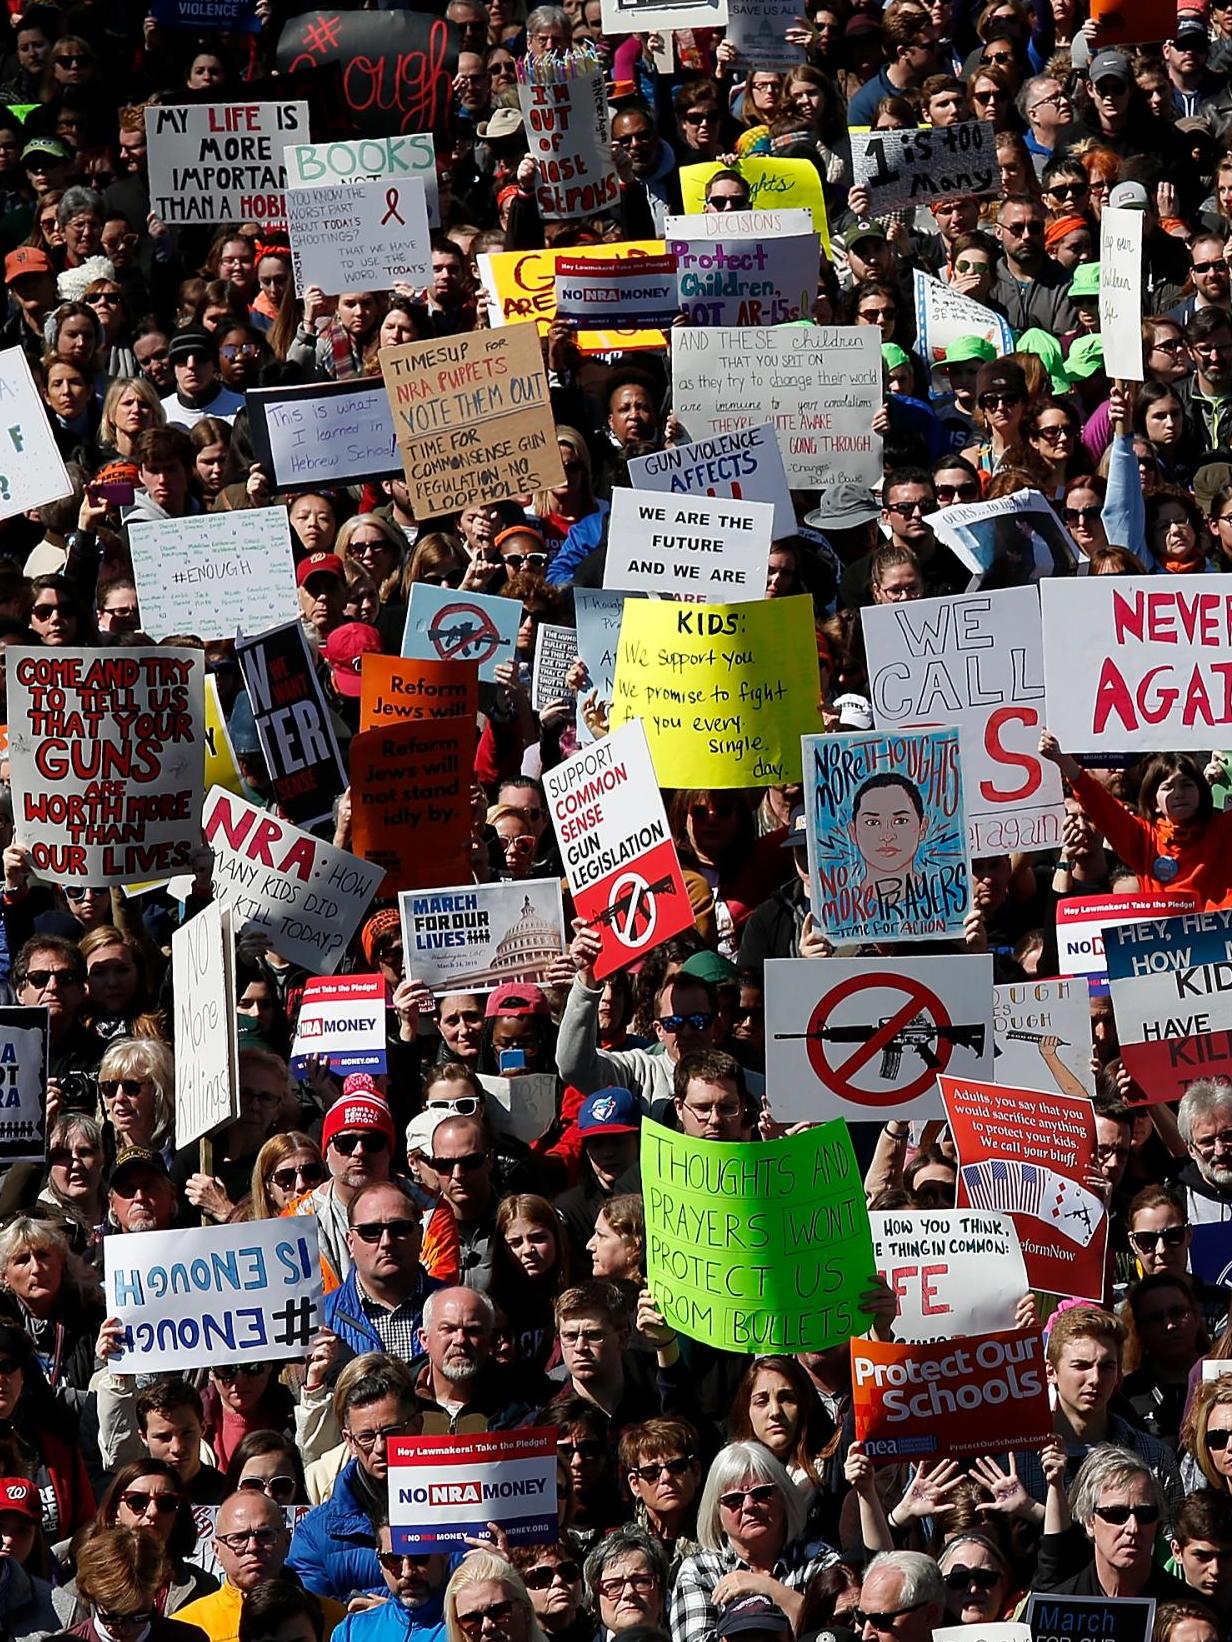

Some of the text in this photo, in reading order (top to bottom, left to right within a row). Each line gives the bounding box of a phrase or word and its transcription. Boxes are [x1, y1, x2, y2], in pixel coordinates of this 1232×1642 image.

[156, 107, 298, 134] MY LIFE IS
[529, 105, 572, 132] OUT
[200, 137, 271, 161] MORE
[295, 133, 434, 180] BOOKS
[288, 187, 366, 205] YOU KNOW THE
[704, 213, 782, 233] DECISIONS
[670, 242, 767, 270] Protect
[679, 270, 782, 298] Children,
[679, 330, 864, 350] AND THESE children
[720, 354, 823, 367] THAT YOU SPIT ON
[397, 357, 507, 404] NRA PUPPETS
[400, 373, 543, 433] VOTE THEM OUT
[670, 453, 758, 492] AFFECTS
[638, 507, 753, 530] WE ARE THE
[652, 536, 724, 553] FUTURE
[173, 560, 253, 585] #ENOUGH
[677, 610, 747, 635] KIDS:
[17, 659, 195, 687] COME AND TRY
[36, 740, 163, 781] GUNS
[848, 735, 959, 817] THOUGHTS
[556, 763, 628, 819] COMMON
[561, 807, 604, 843] SENSE
[32, 843, 88, 873] OUR
[568, 837, 602, 866] GUN
[573, 821, 666, 888] LEGISLATION
[414, 895, 477, 914] MARCH
[281, 916, 344, 955] TODAY?
[415, 911, 489, 932] FOR OUR
[416, 931, 465, 950] LIVES
[1132, 947, 1192, 976] HOW
[1143, 1014, 1212, 1042] HAVE
[954, 1088, 1083, 1120] Adults, you say that you
[981, 1136, 1077, 1166] We call your bluff.
[647, 1134, 848, 1197] THOUGHTS AND
[651, 1188, 769, 1248] PRAYERS
[114, 1237, 312, 1306] IS ENOUGH
[652, 1241, 844, 1297] PROTECT US
[854, 1336, 1038, 1387] Protect Our
[883, 1366, 1042, 1421] Schools
[398, 1448, 414, 1456] Hey
[417, 1444, 472, 1455] Lawmakers!
[500, 1442, 513, 1450] the
[516, 1438, 547, 1447] Pledge!
[865, 1438, 897, 1455] nea
[950, 1435, 1046, 1451] ProtectOurSchools.com
[400, 1479, 546, 1503] NO NRA MONEY
